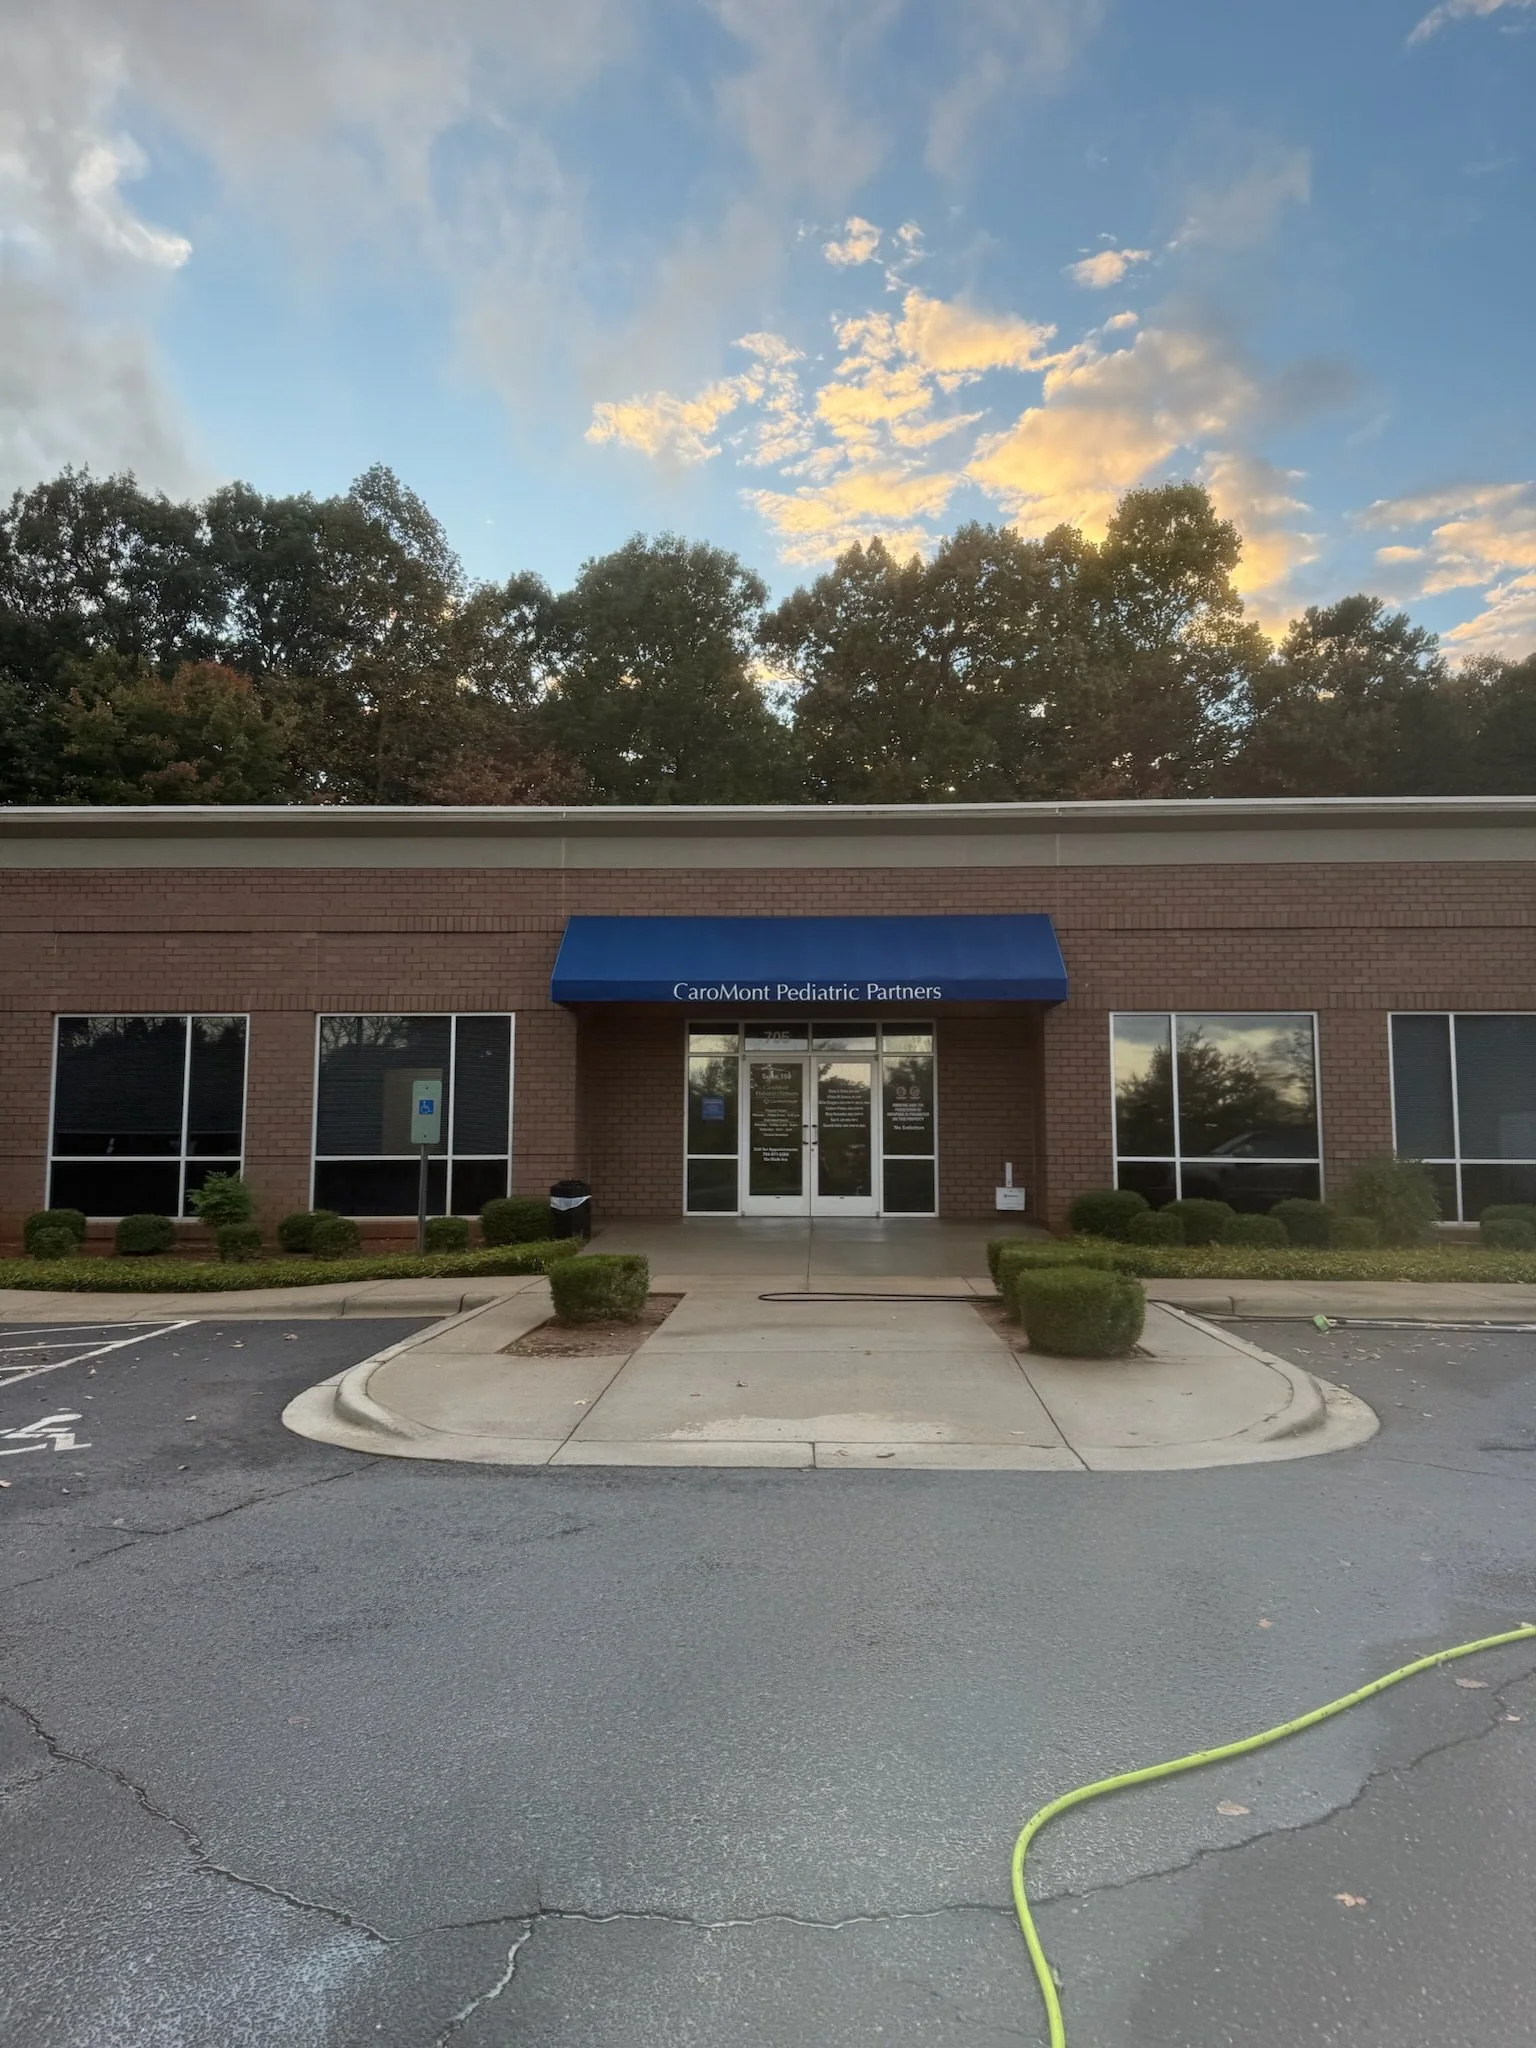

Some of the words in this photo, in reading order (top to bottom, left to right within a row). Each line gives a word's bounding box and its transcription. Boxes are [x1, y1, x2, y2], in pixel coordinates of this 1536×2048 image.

[673, 982, 770, 1001] CaroMont
[777, 982, 860, 1001] Pediatric
[867, 982, 942, 1000] Partners
[763, 1031, 791, 1044] 705
